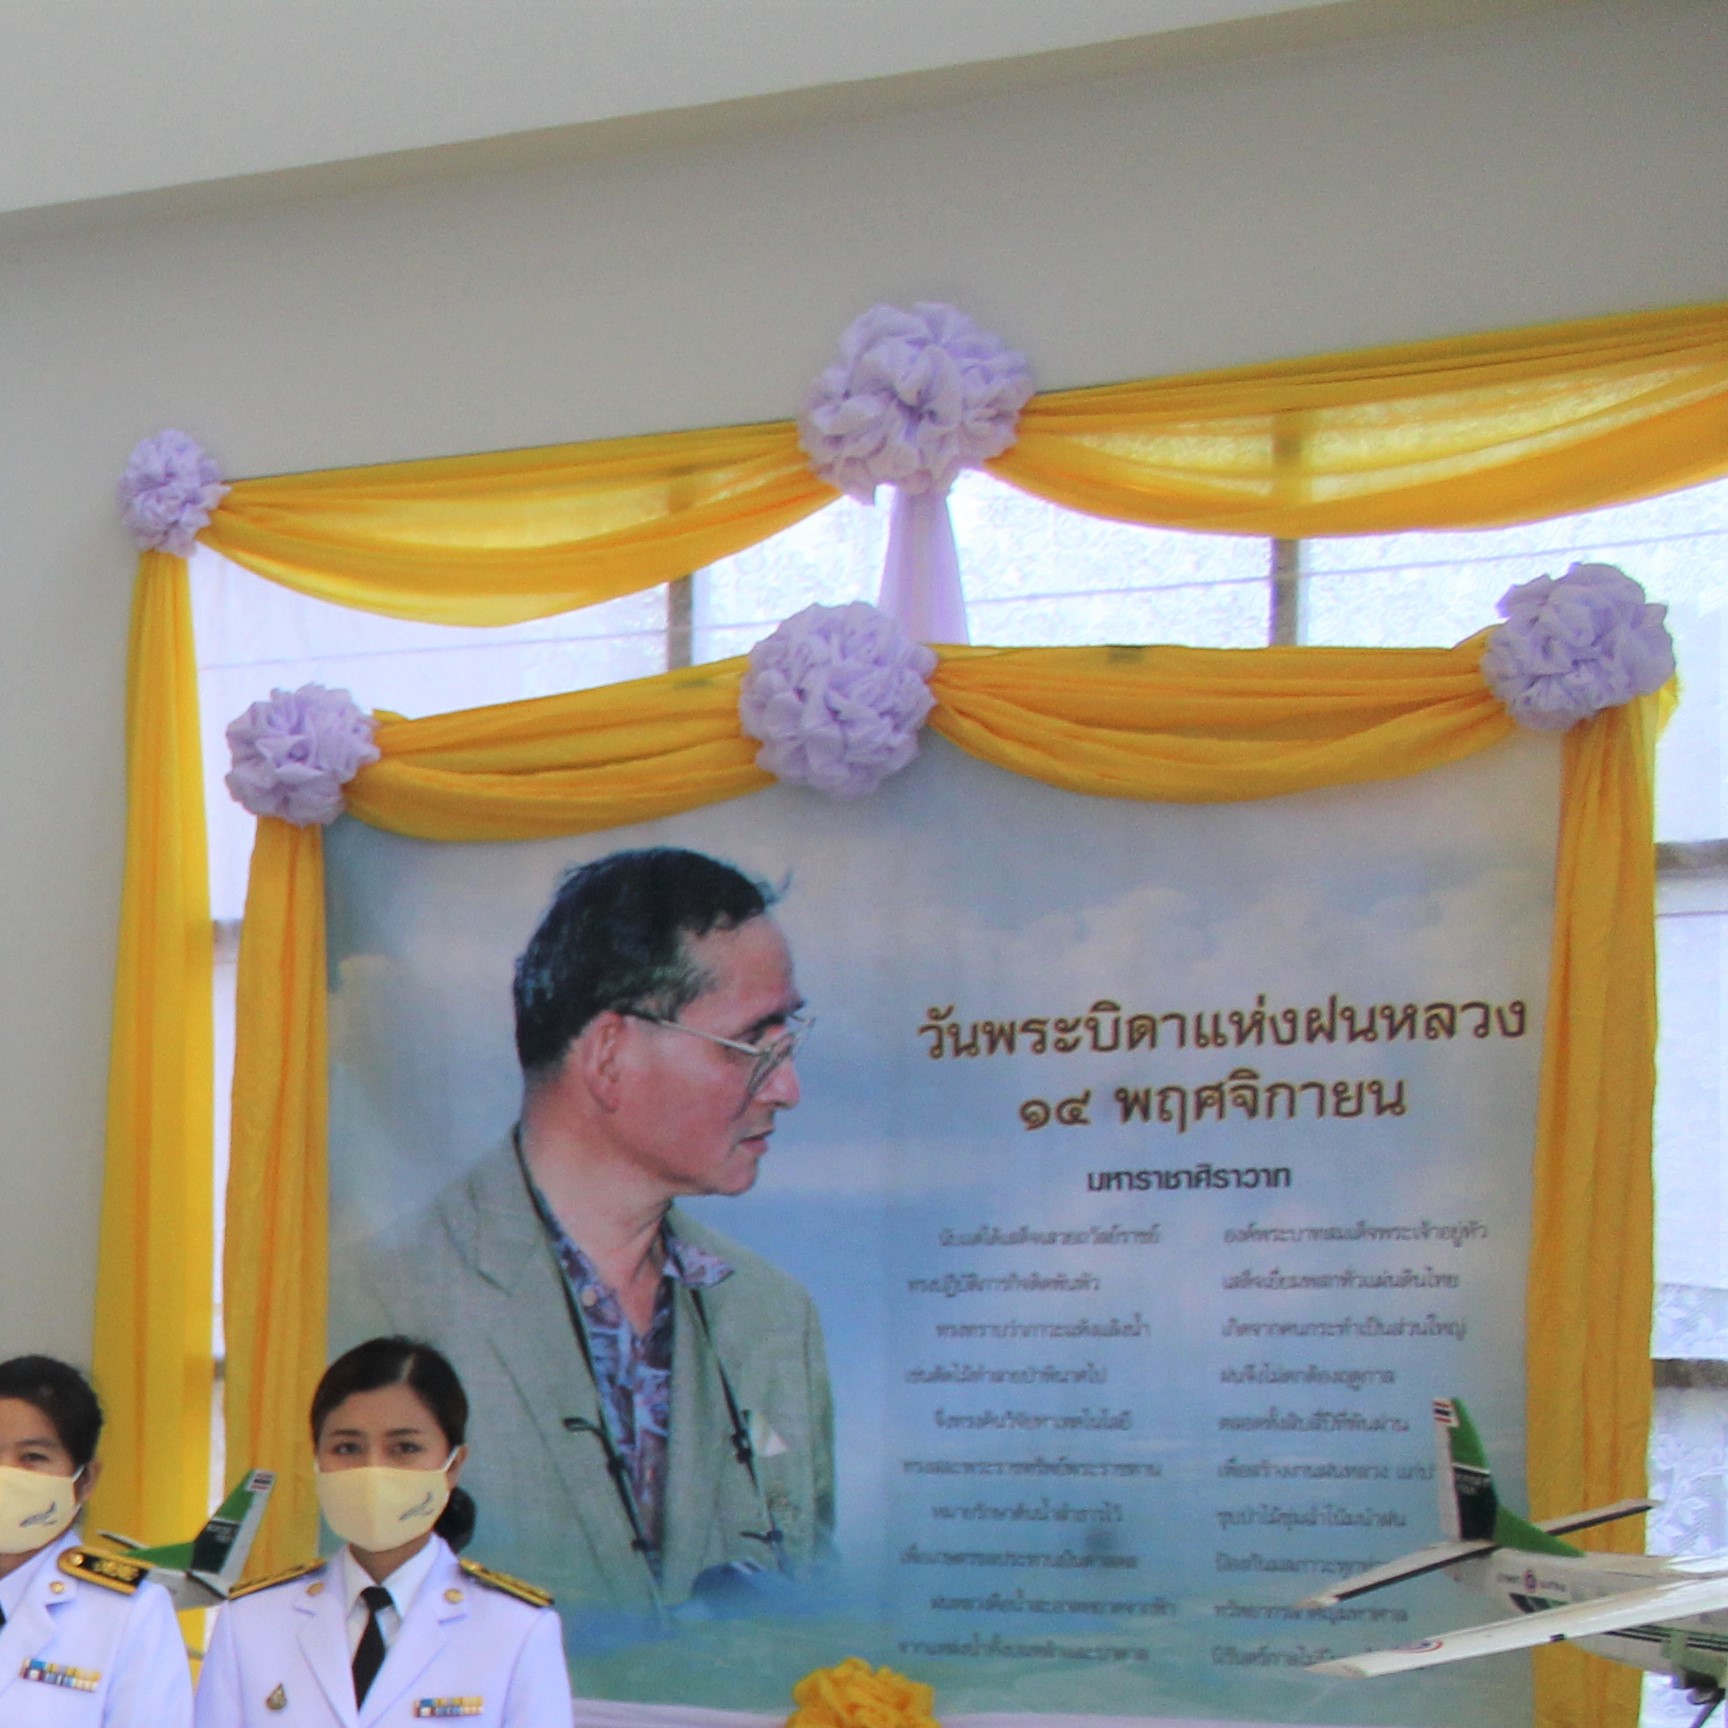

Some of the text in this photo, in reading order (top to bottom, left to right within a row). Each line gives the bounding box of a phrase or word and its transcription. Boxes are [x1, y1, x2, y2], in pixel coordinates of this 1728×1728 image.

[917, 994, 1528, 1060] วันพระบิดาแห่งฝนหลวง
[1017, 1067, 1407, 1134] ๑๔ พฤศจิกายน
